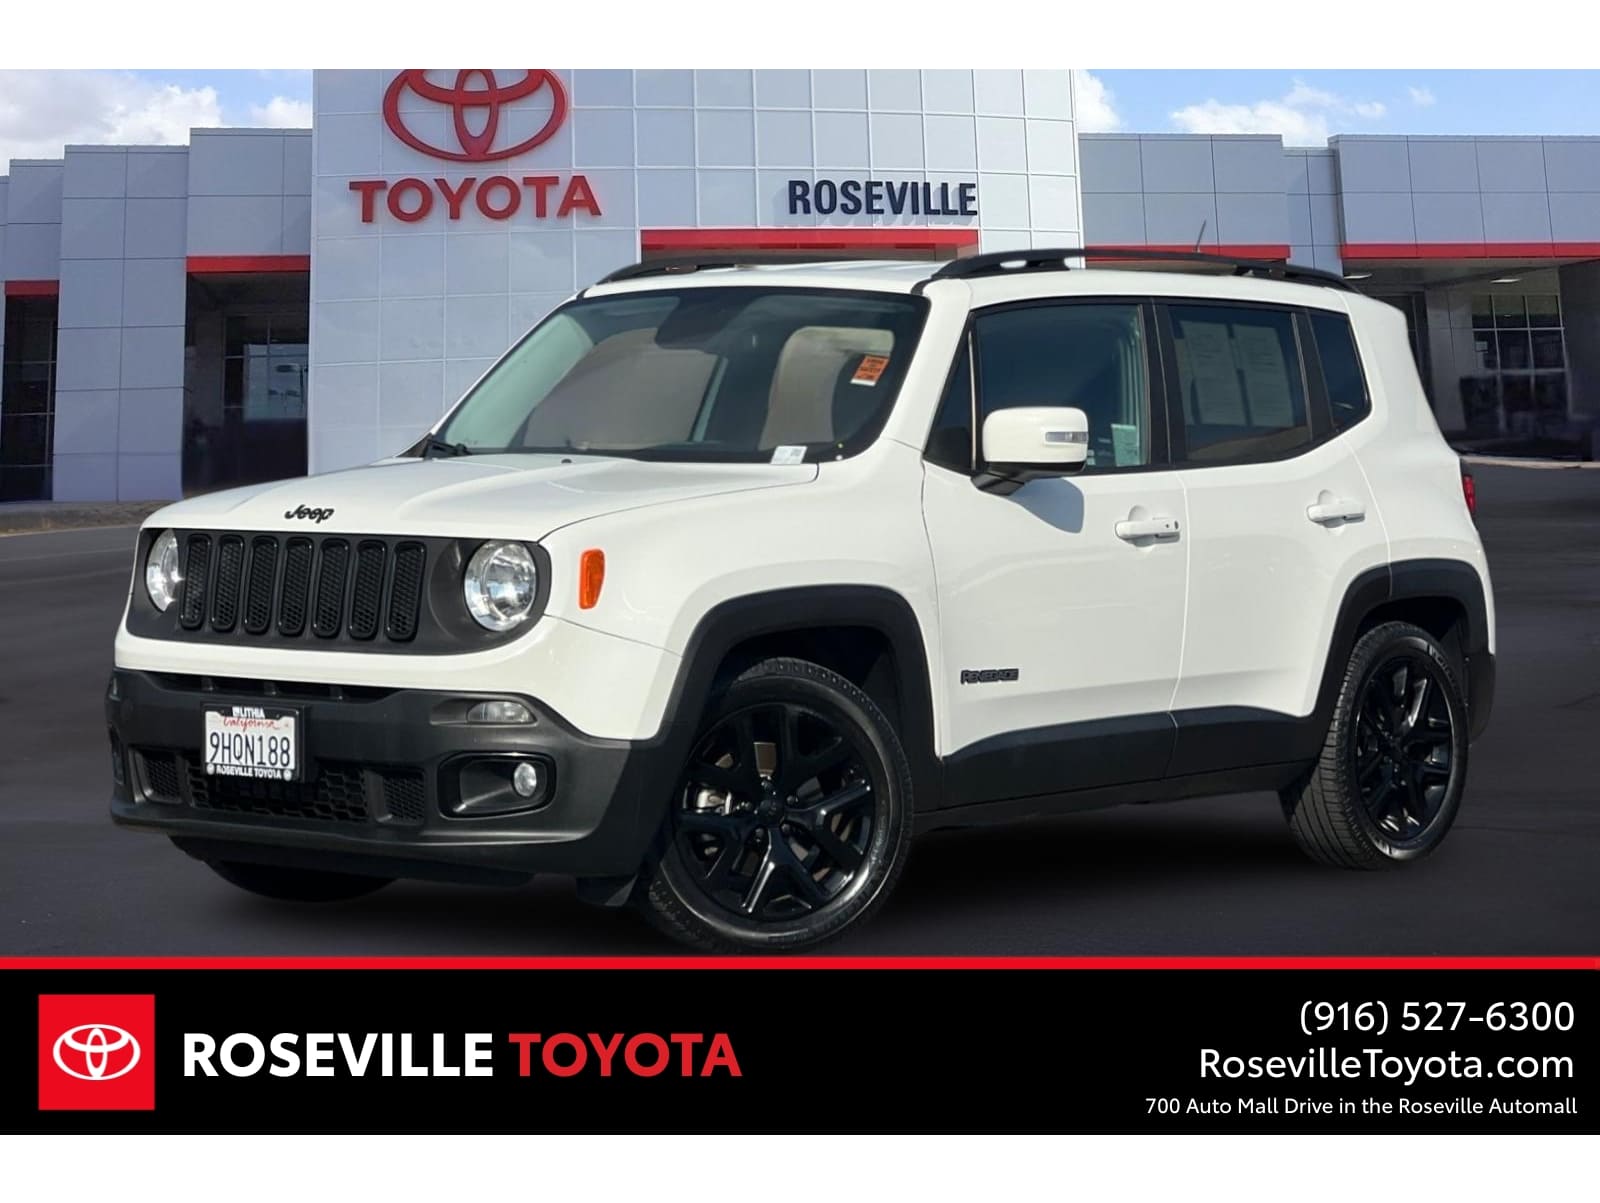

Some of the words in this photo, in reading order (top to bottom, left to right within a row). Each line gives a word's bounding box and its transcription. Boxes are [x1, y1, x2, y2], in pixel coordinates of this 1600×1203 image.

[349, 175, 602, 223] TOYOTA
[788, 179, 978, 216] ROSEVILLE
[284, 504, 335, 524] Jeep
[960, 668, 1019, 685] RENEGADE
[216, 764, 253, 777] ROSEVILLE
[254, 767, 282, 779] TOYOTA
